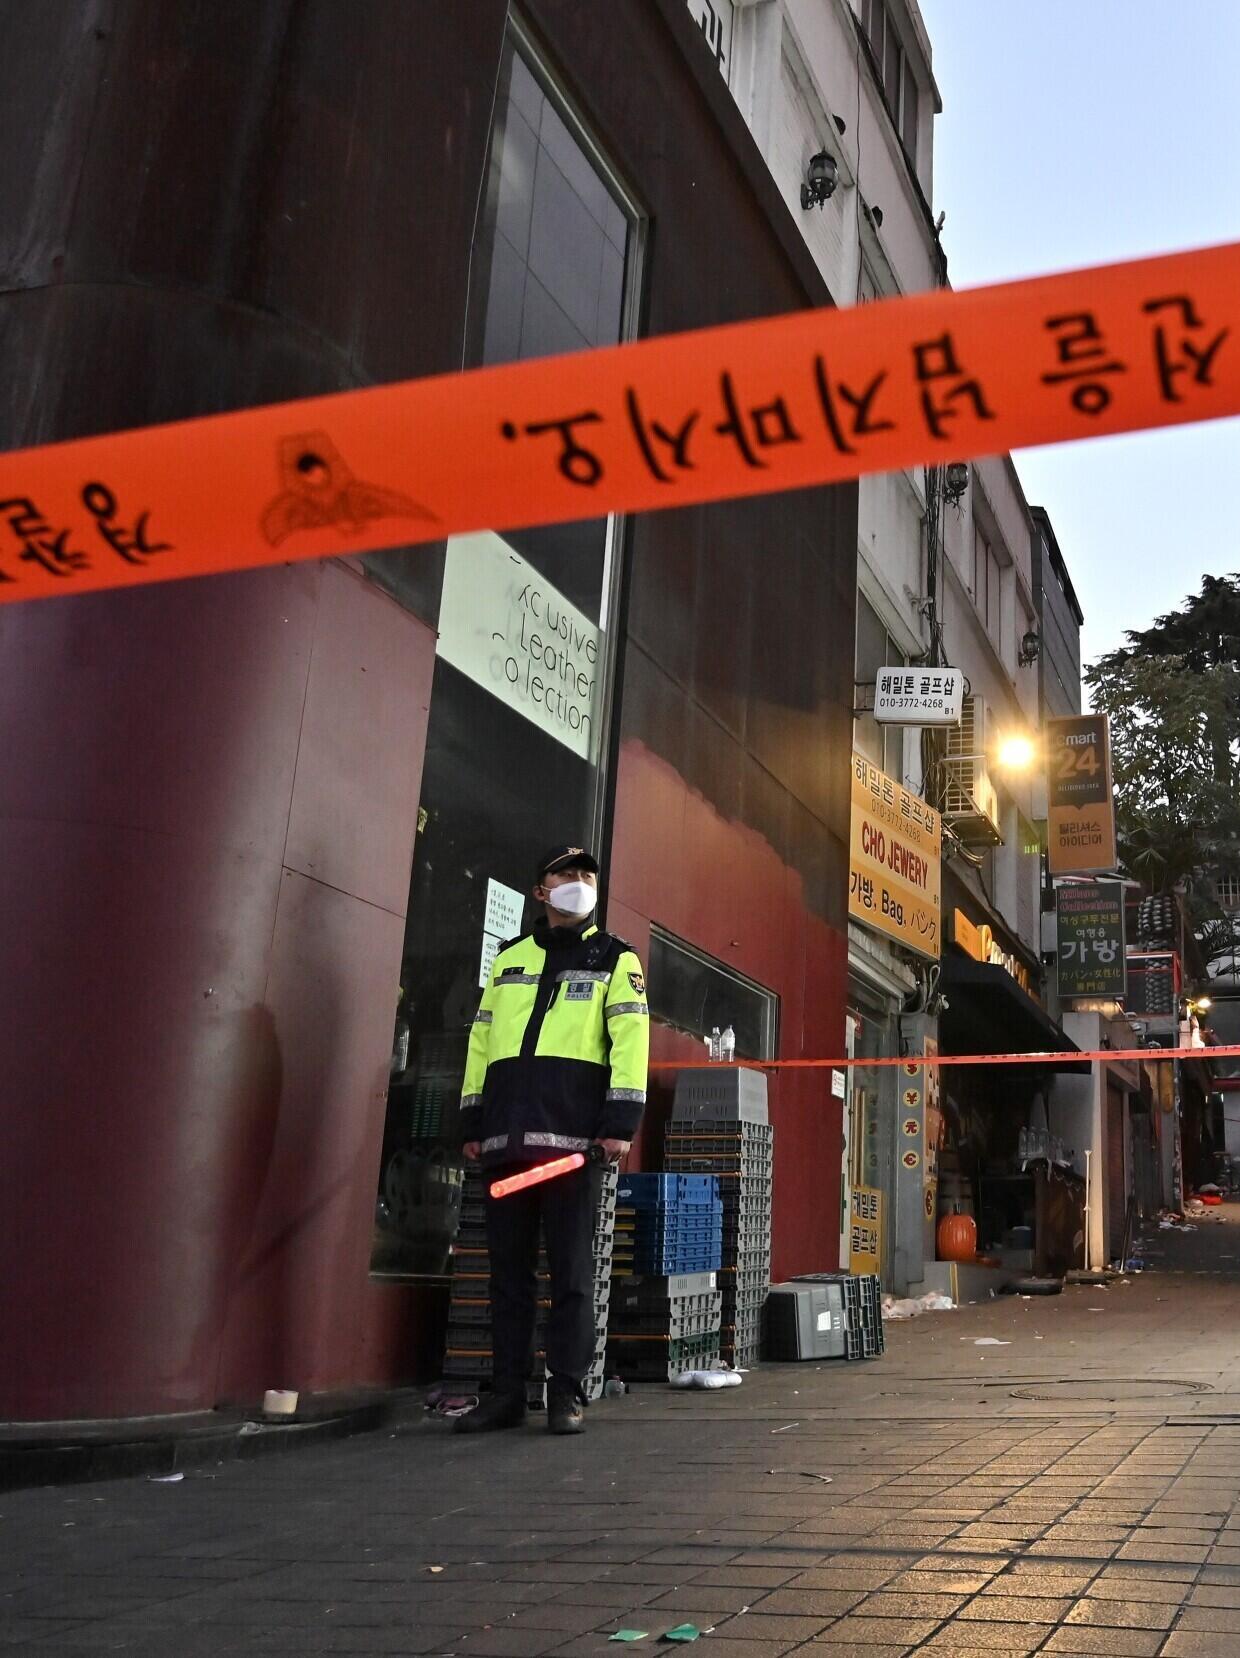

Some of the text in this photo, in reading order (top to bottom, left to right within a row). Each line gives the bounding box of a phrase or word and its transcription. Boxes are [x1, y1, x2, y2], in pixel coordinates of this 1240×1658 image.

[501, 329, 995, 487] 넘지마시오.
[0, 481, 176, 584] 경찰
[520, 612, 596, 701] Leather
[881, 675, 955, 696] 해밀톤 골프샵
[879, 698, 944, 708] 010-3772-4268
[944, 707, 954, 715] B1
[1057, 745, 1101, 779] 24
[855, 758, 935, 836] 해밀톤 골프샵
[862, 820, 928, 890] CHO JEWERY
[850, 871, 877, 912] 가방,
[881, 888, 907, 927] Bag,
[1075, 927, 1106, 938] 여행용
[1061, 939, 1120, 963] 가방
[852, 1191, 878, 1221] 해밀톤
[852, 1226, 878, 1255] 골프샵
